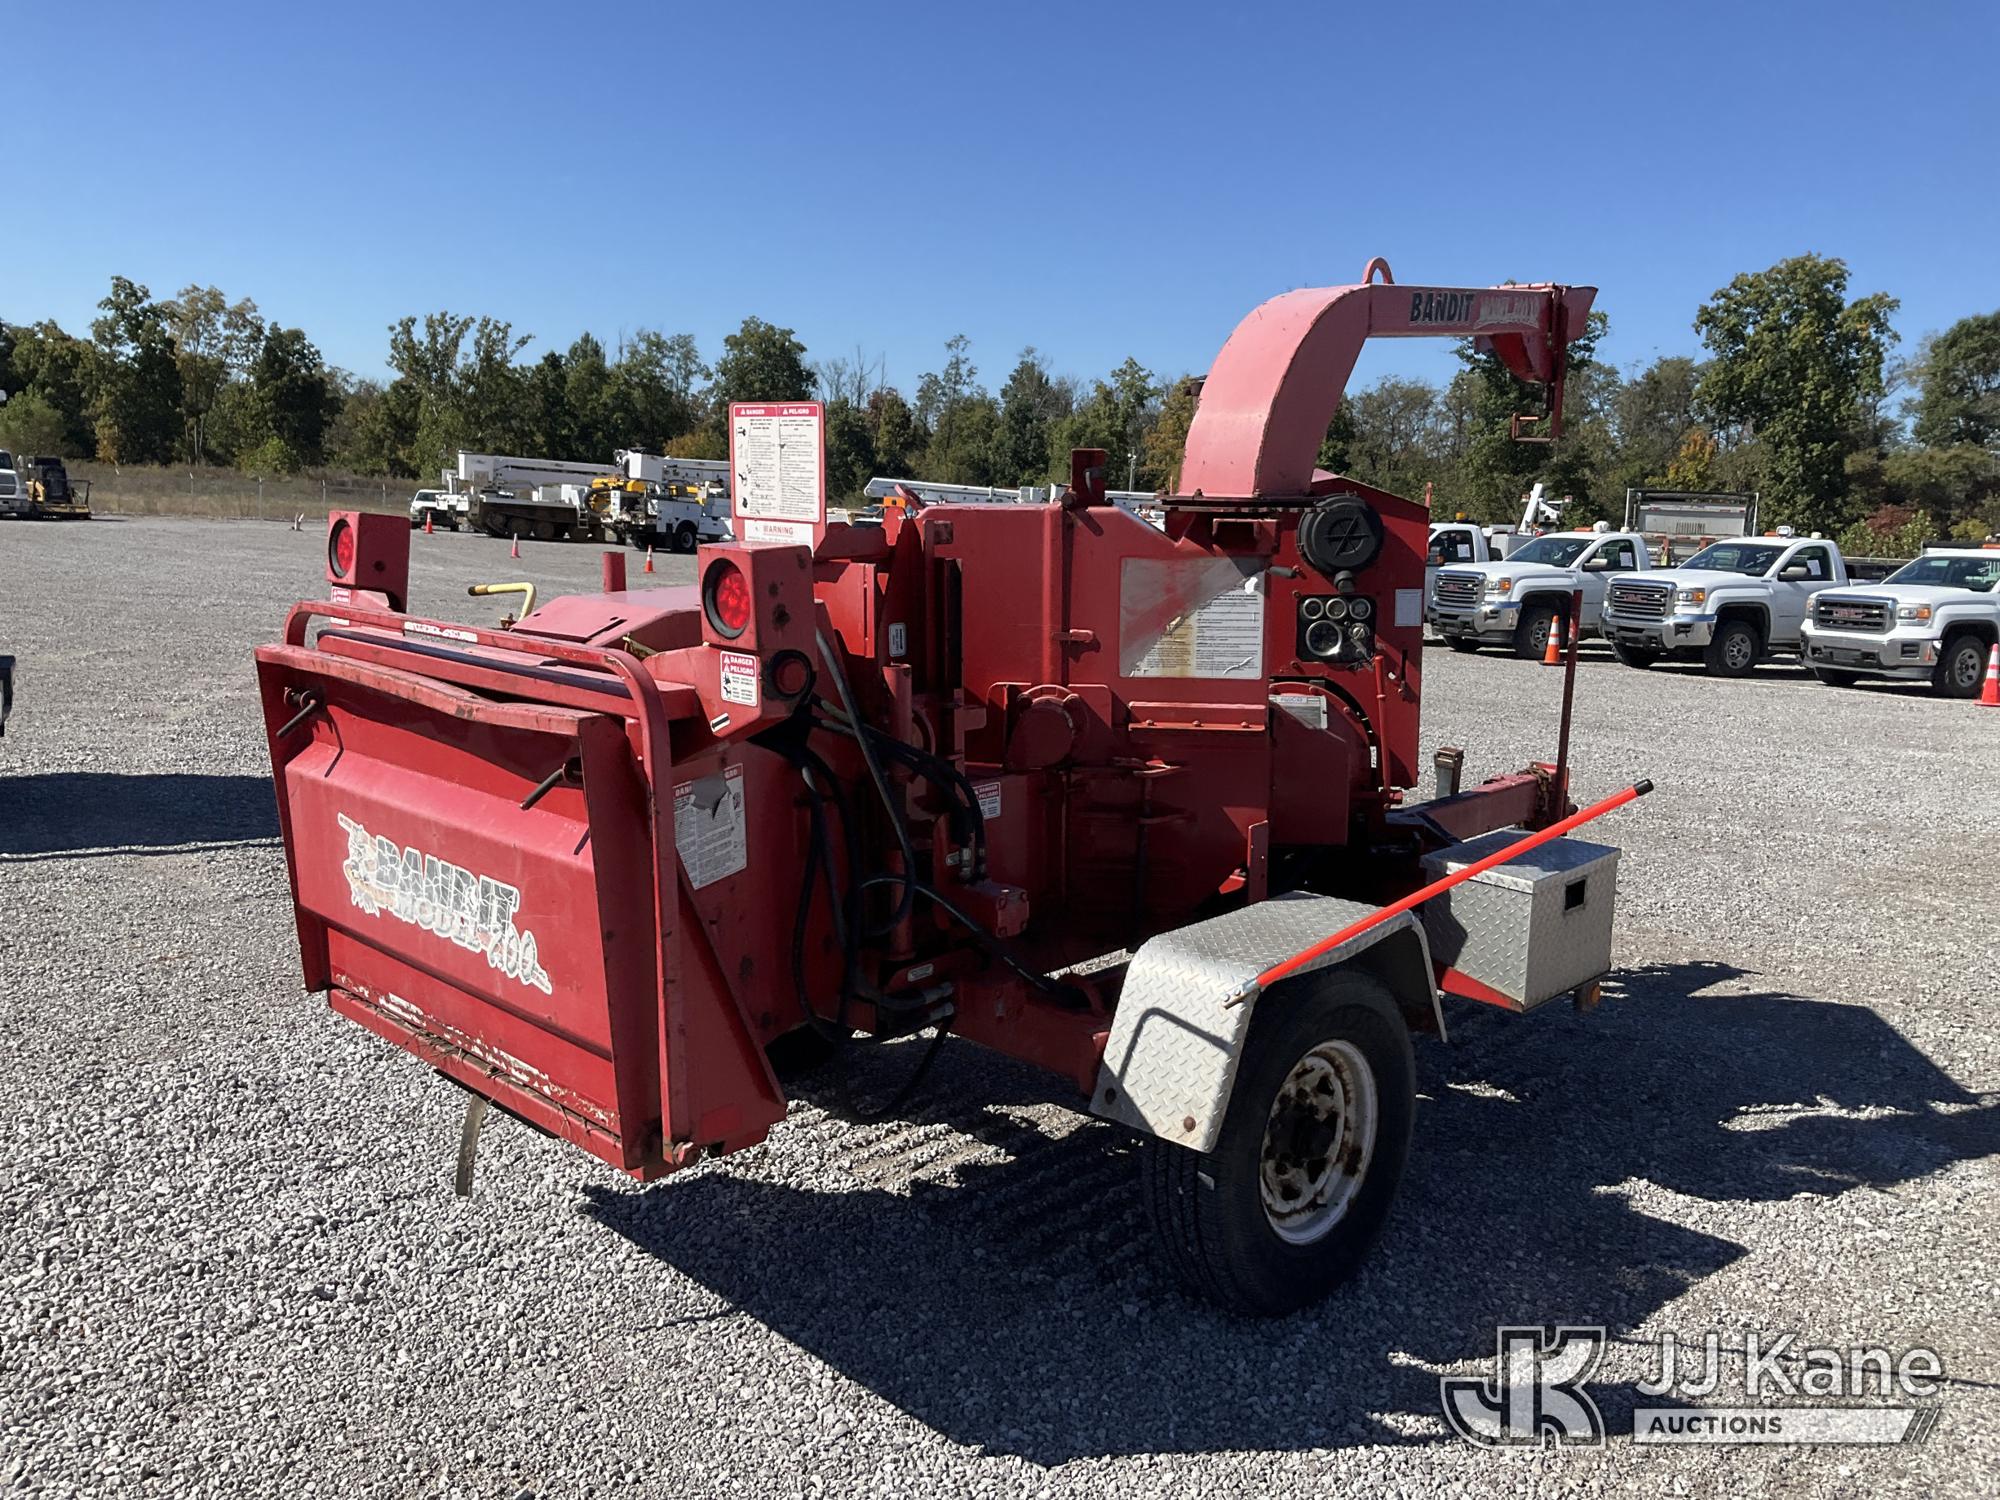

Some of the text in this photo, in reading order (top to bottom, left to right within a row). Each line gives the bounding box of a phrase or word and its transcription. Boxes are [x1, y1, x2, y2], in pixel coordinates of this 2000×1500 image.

[1409, 292, 1475, 321] BANDIT
[730, 656, 753, 665] DANGER
[730, 665, 754, 675] PELIGRO
[376, 835, 520, 936] BANDIT
